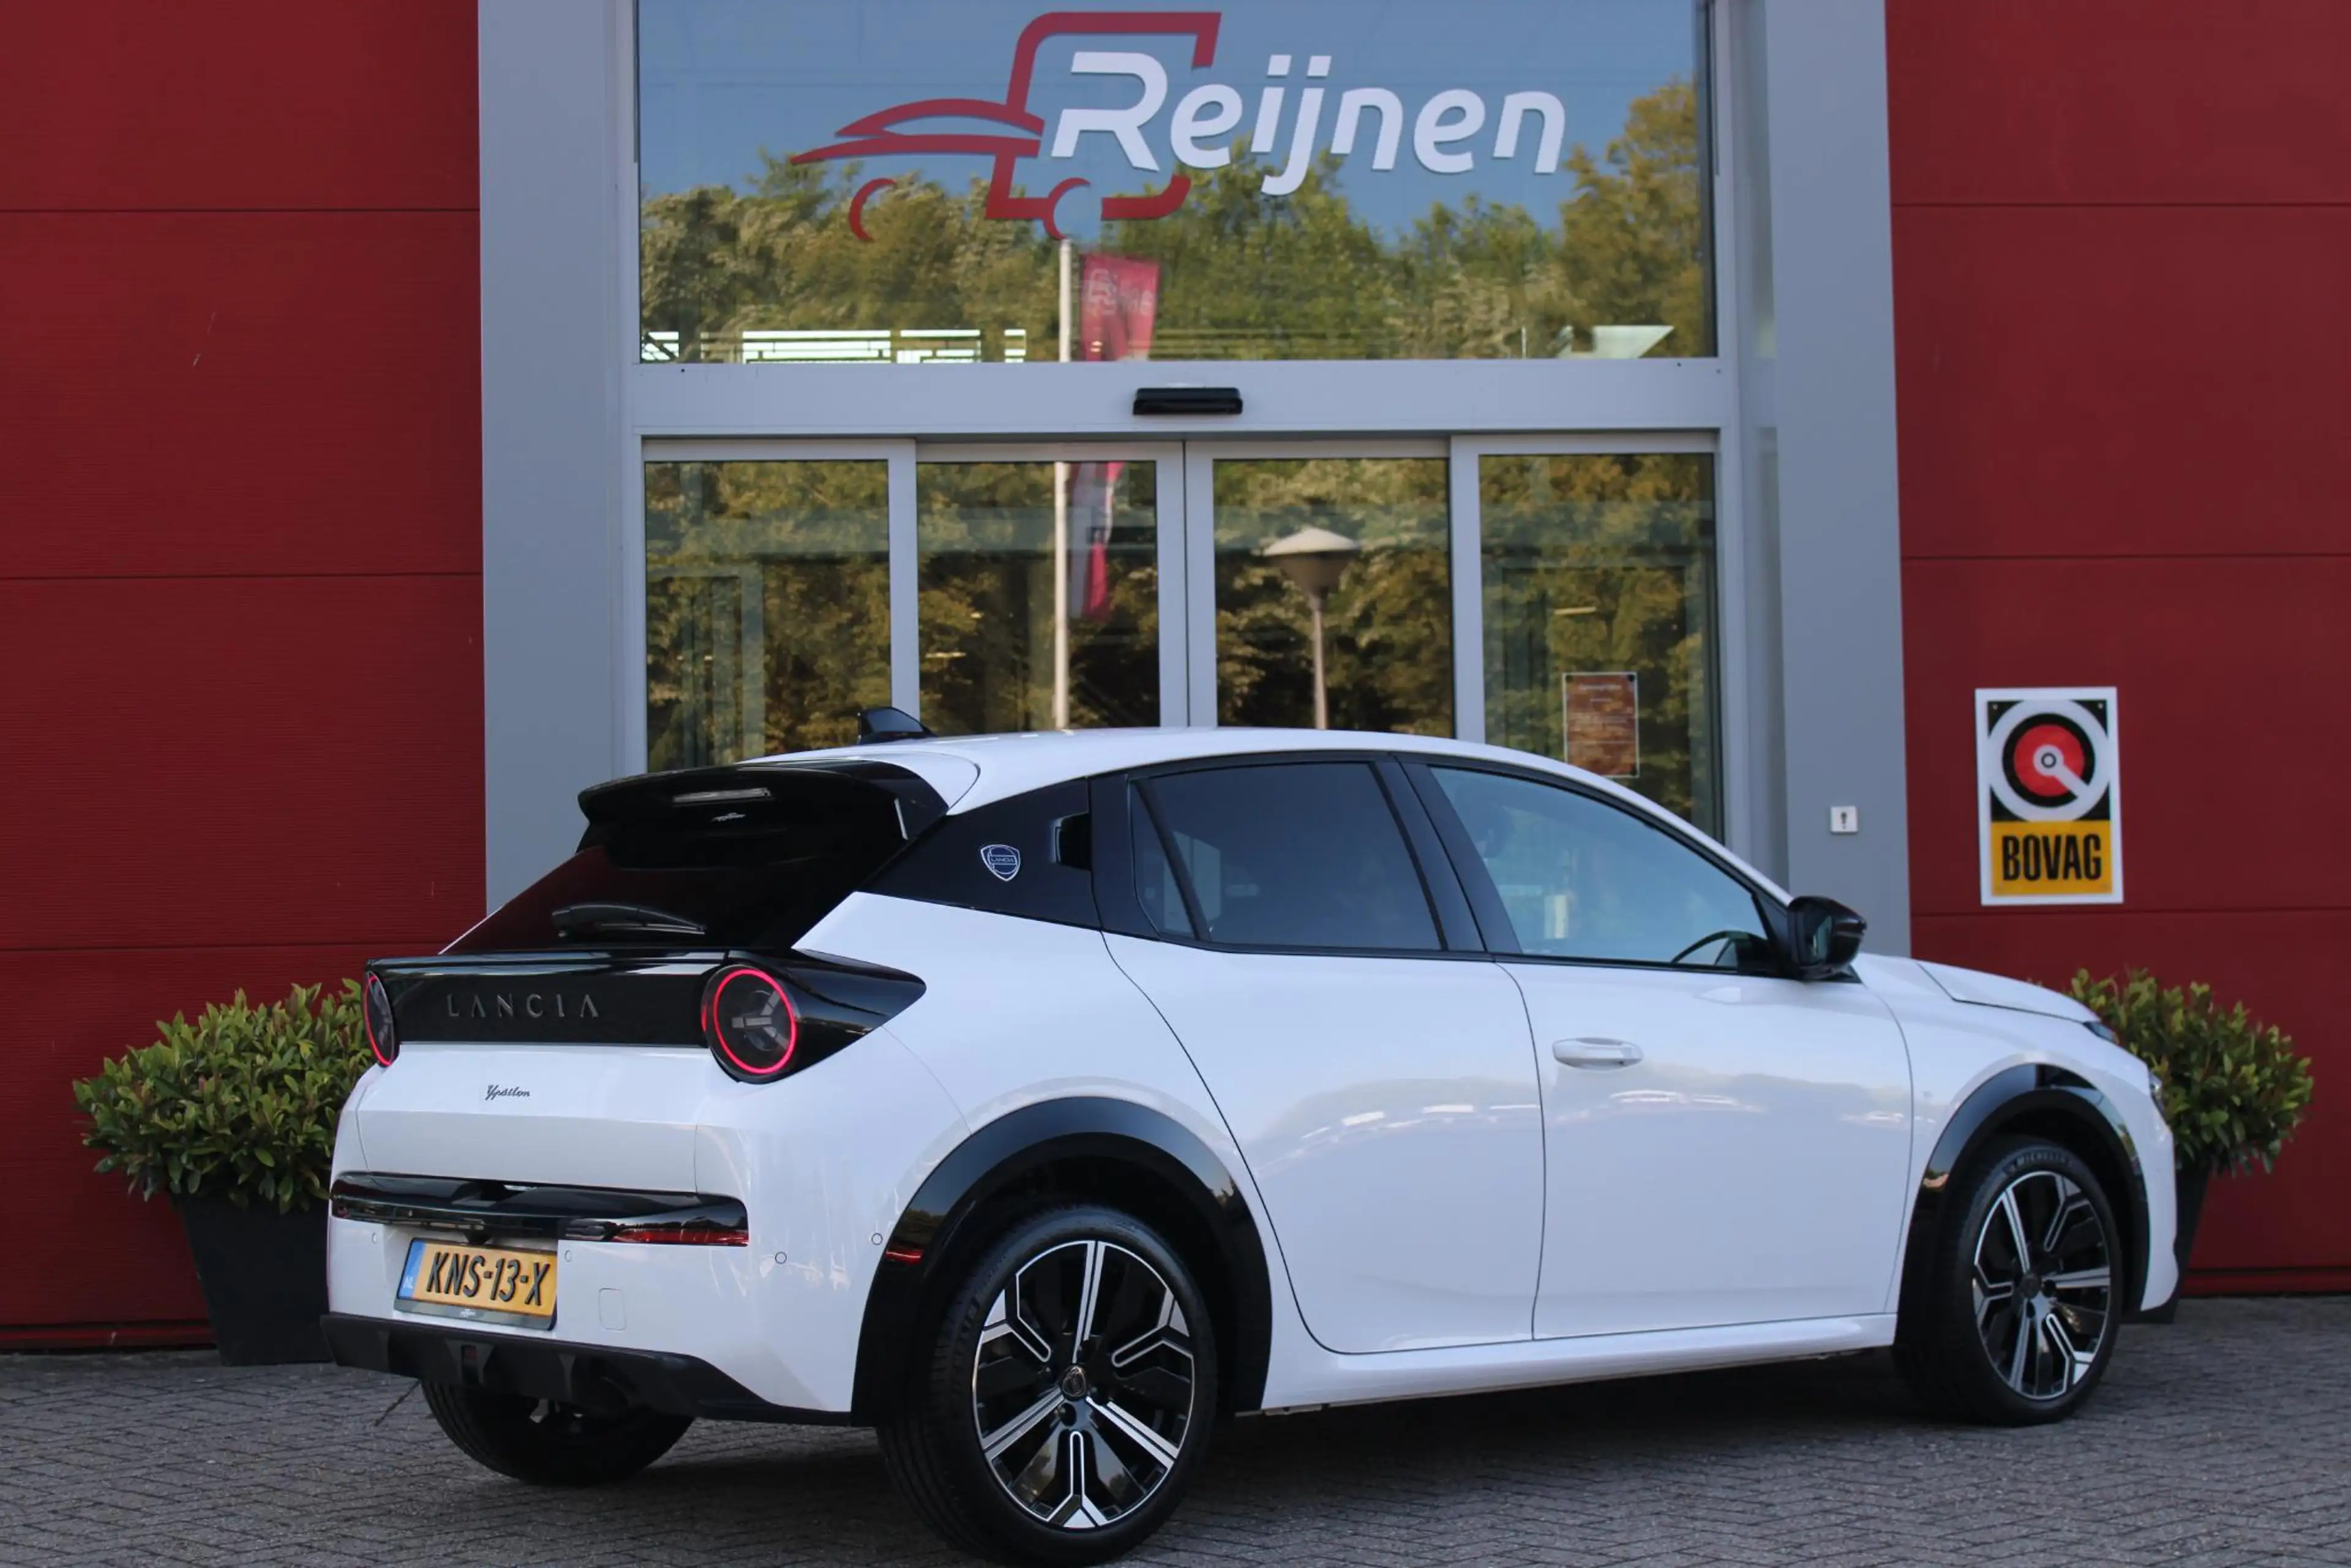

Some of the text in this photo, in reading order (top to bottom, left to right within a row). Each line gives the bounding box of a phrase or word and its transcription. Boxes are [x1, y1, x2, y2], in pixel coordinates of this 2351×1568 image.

[1051, 51, 1566, 195] Reijnen
[2001, 833, 2102, 881] BOVAG
[446, 993, 599, 1018] LANCIA
[485, 1084, 531, 1100] Ypsilon
[426, 1252, 551, 1306] KNS-13-X
